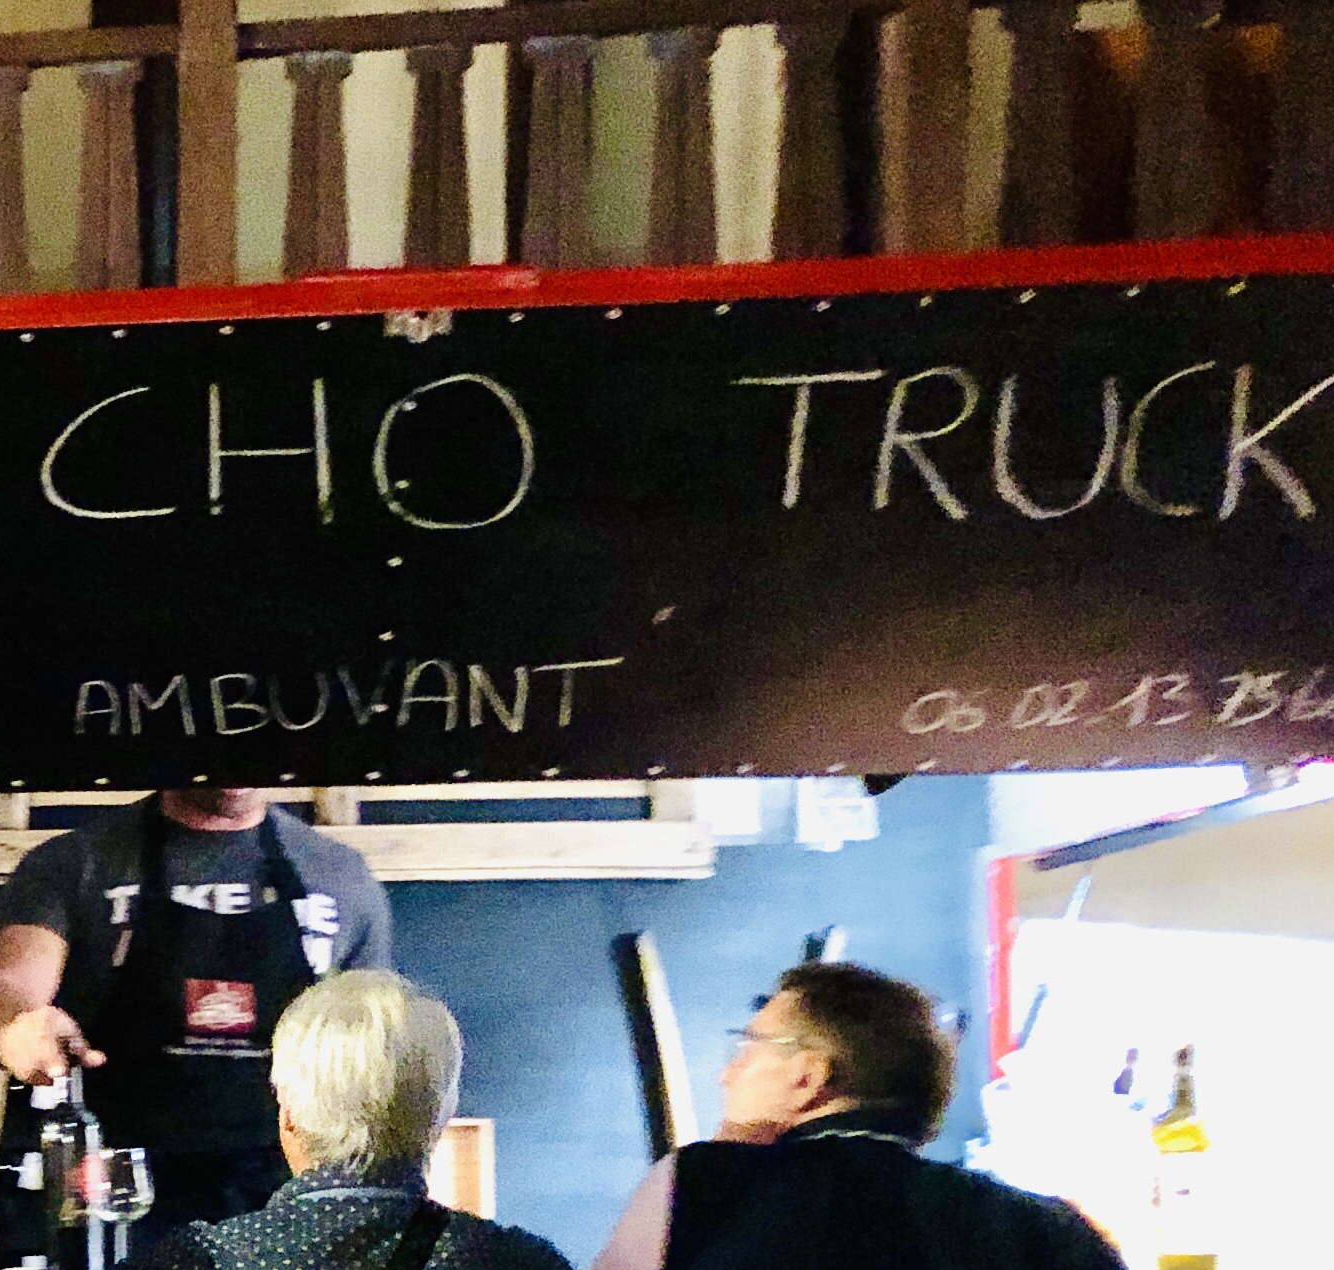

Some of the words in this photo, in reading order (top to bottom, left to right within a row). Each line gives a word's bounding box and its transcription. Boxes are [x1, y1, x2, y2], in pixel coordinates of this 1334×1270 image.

[40, 372, 535, 531] CHO
[730, 360, 1334, 522] TRUCK
[1009, 679, 1091, 729] 02
[1084, 671, 1192, 728] 13
